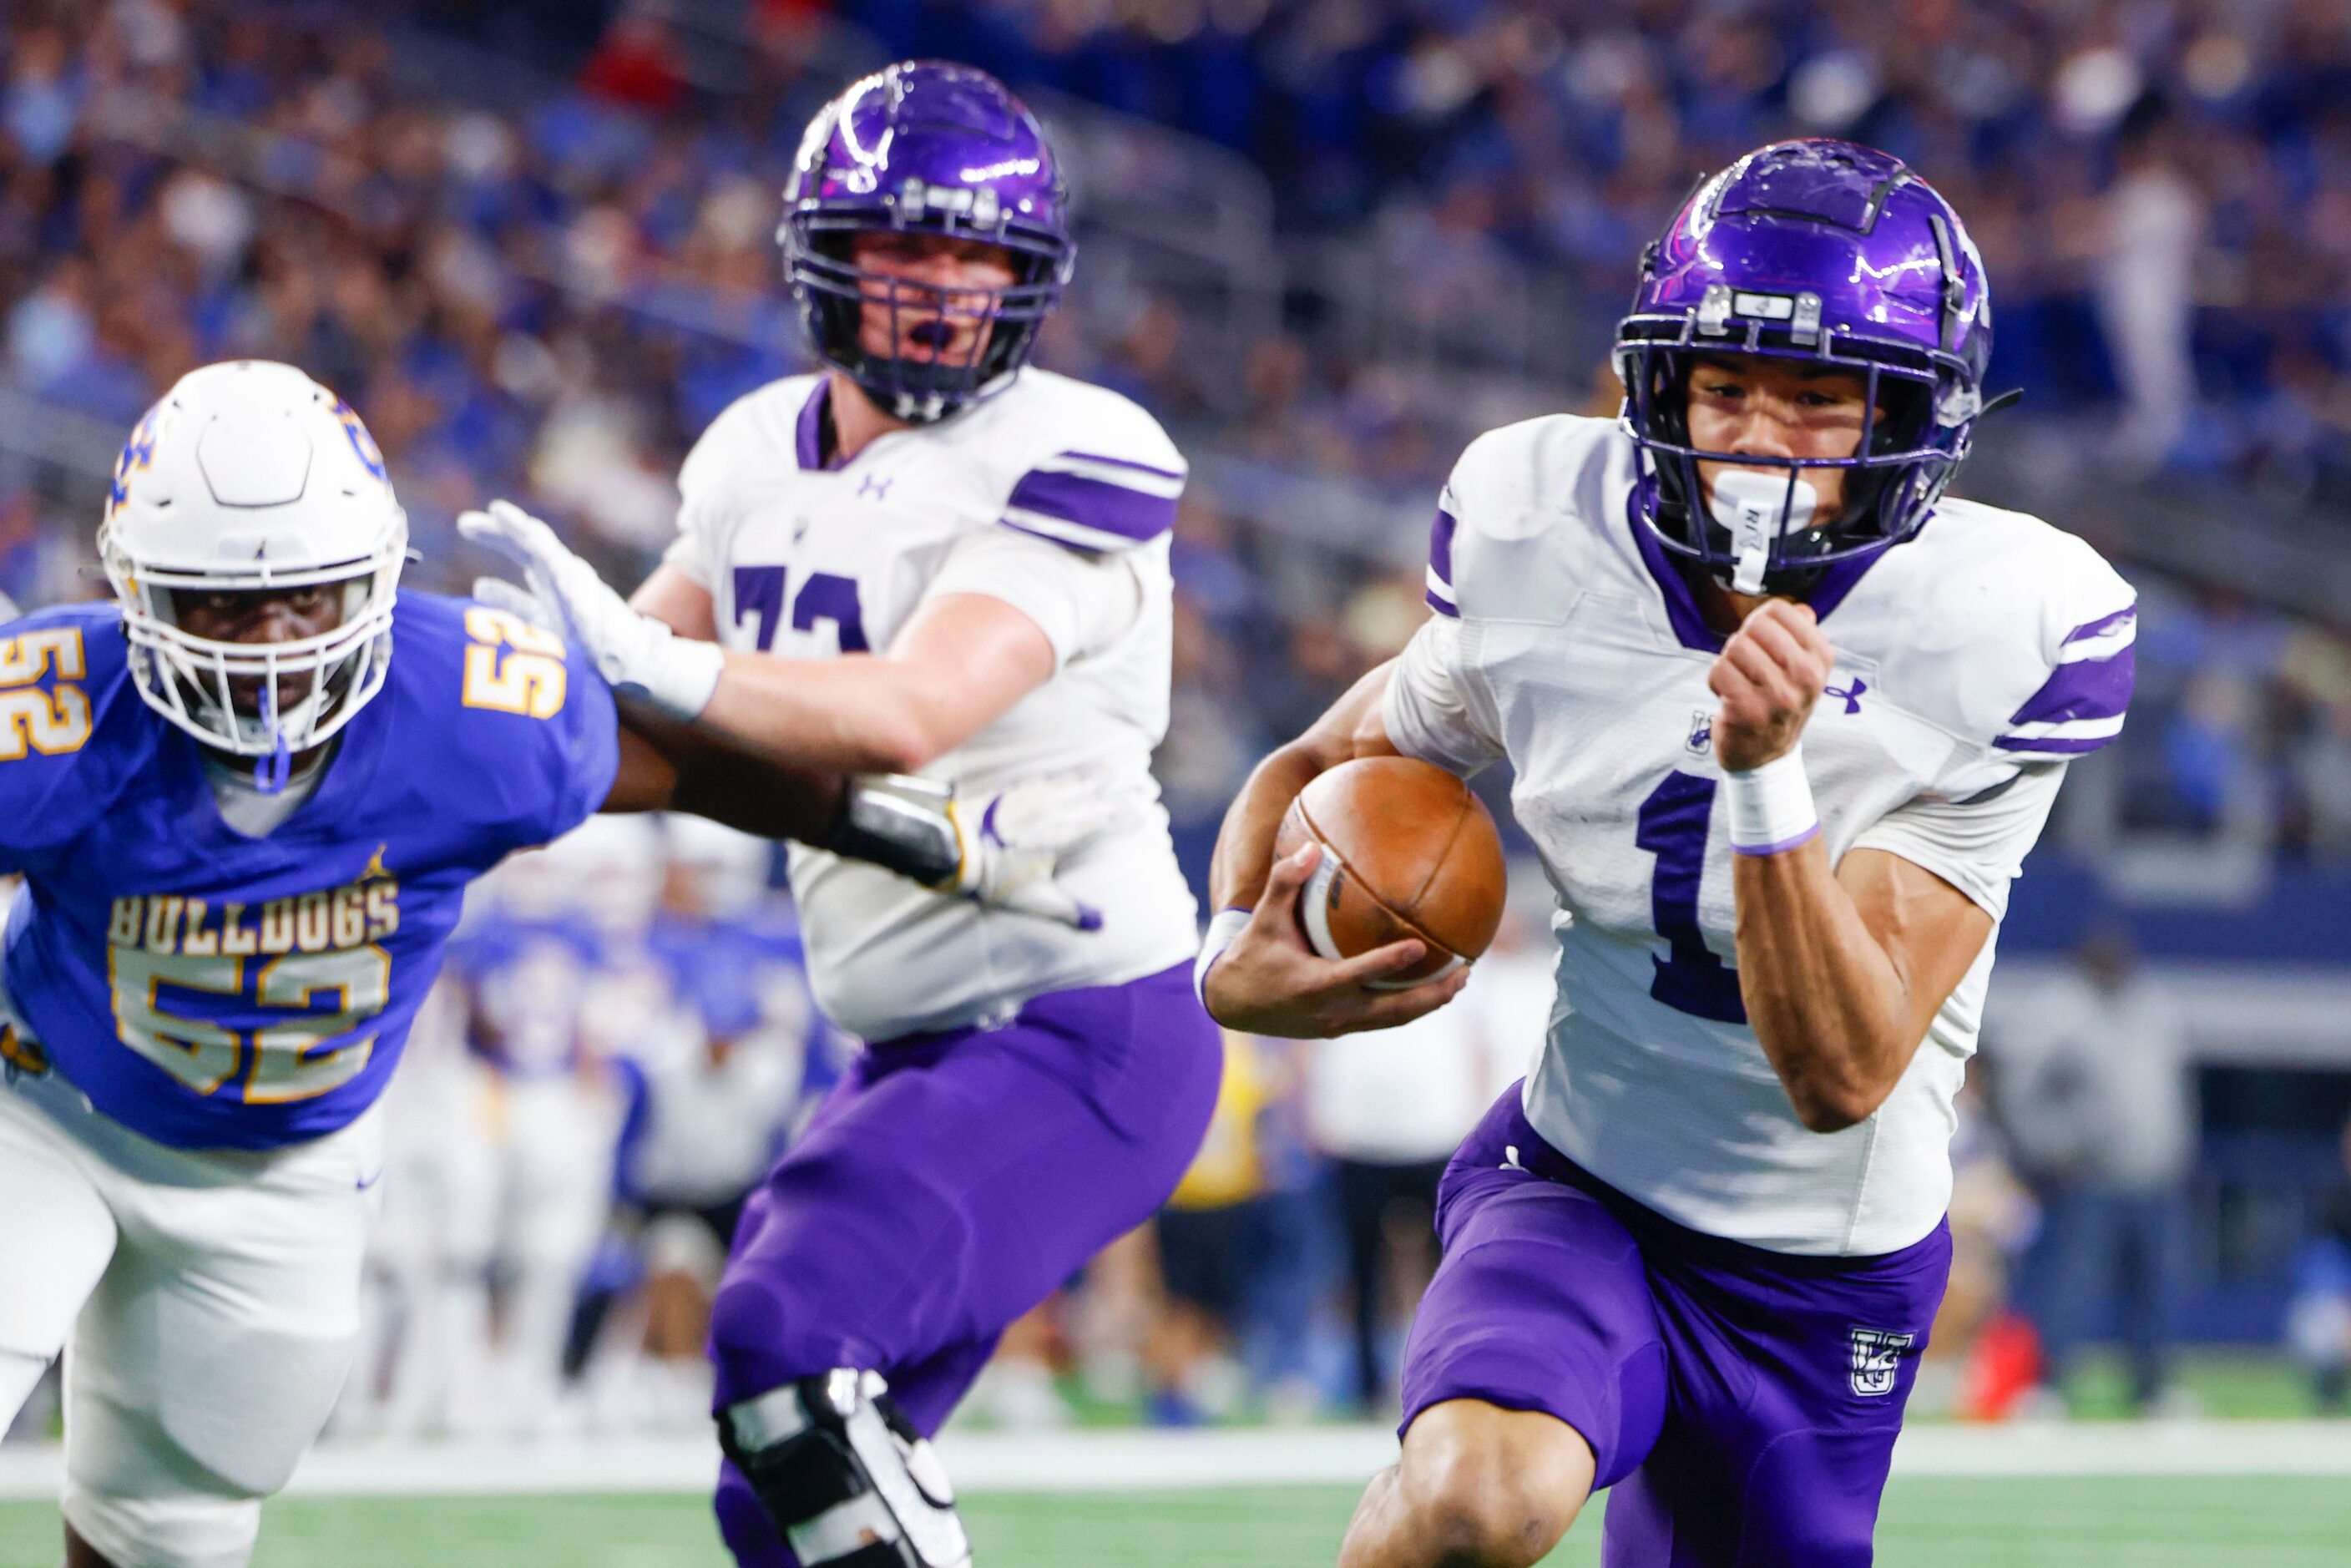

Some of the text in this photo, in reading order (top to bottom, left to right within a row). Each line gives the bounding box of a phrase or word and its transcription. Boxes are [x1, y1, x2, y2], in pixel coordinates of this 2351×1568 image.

[0, 626, 93, 761] 52
[462, 606, 567, 721] 52
[108, 880, 401, 956] BULLDOGS
[1636, 769, 1747, 1025] 1
[108, 943, 392, 1104] 52
